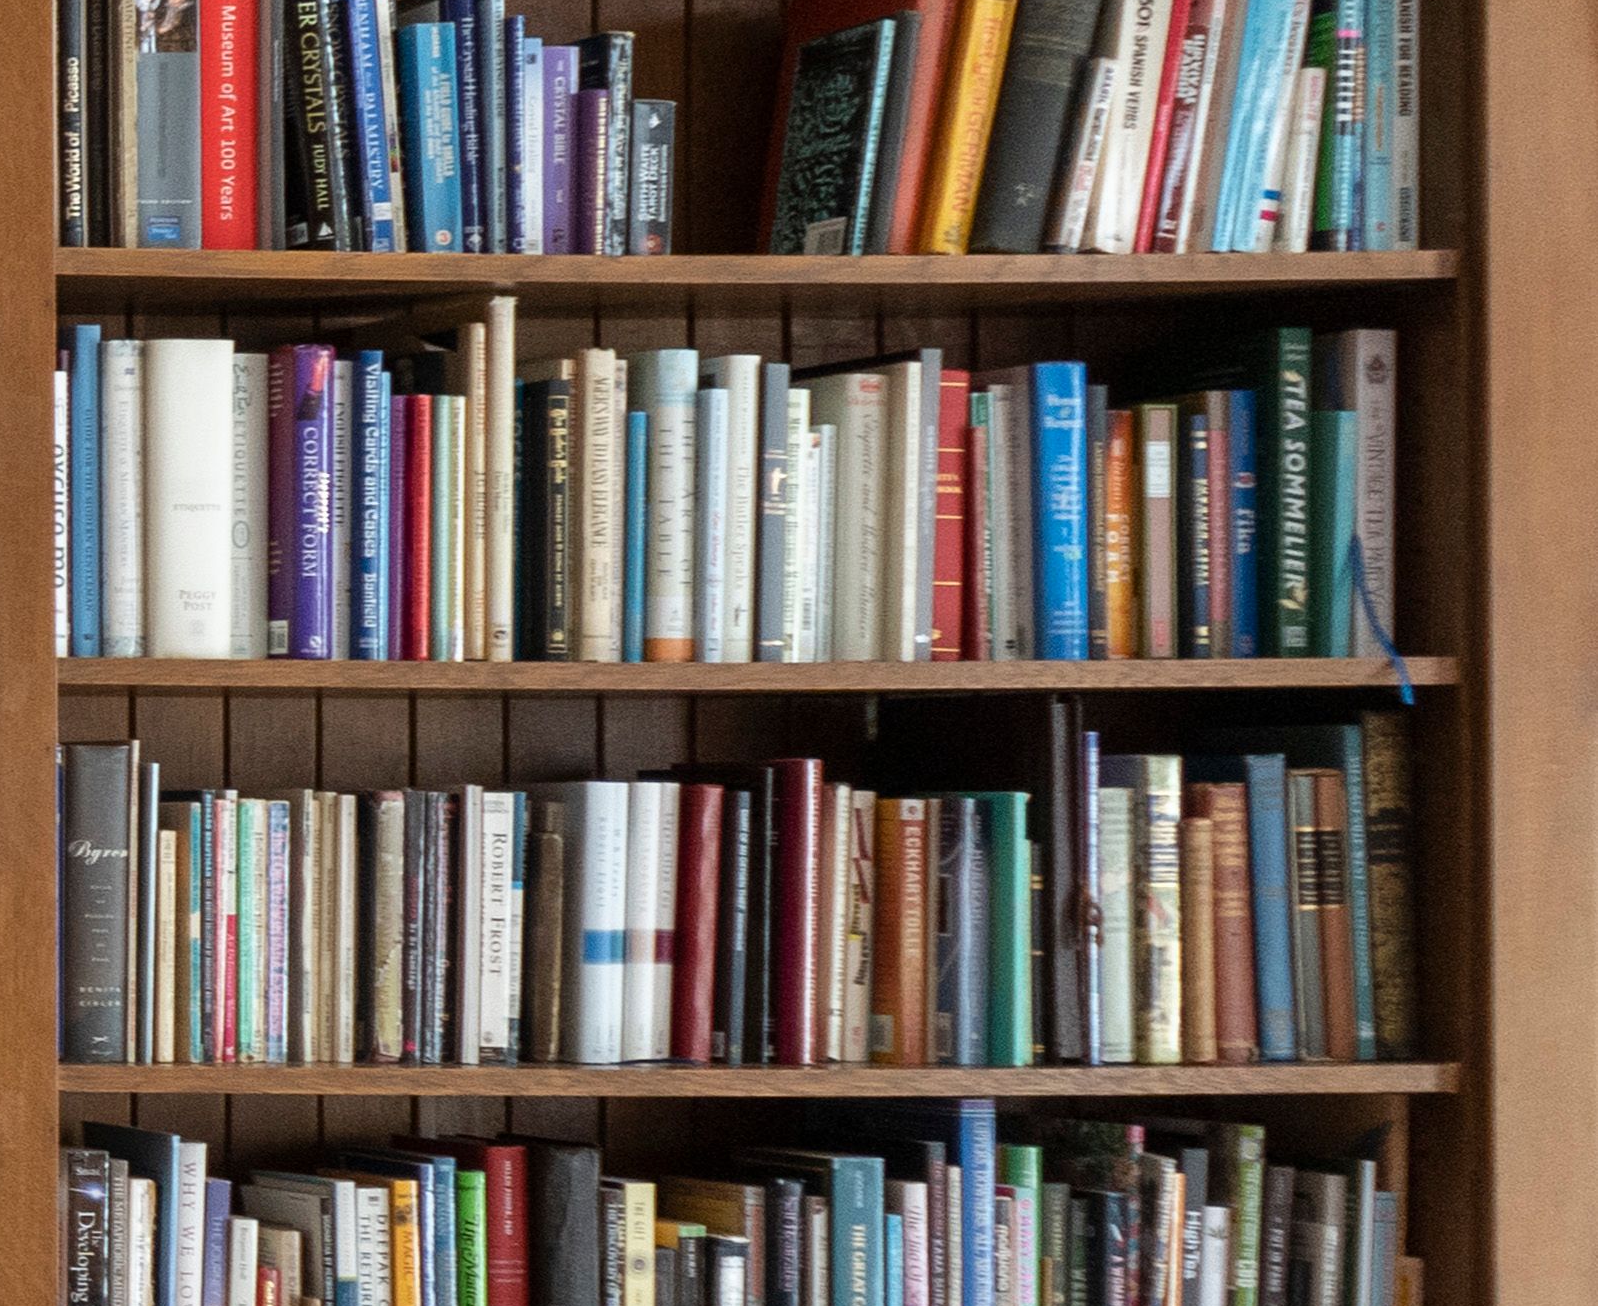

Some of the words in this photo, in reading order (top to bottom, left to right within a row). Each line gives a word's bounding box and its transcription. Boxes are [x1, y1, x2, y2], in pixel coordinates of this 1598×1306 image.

[221, 5, 237, 77] Museum
[219, 82, 238, 100] of
[299, 32, 326, 132] CRYSTALS
[221, 105, 237, 131] Art
[221, 139, 237, 169] 100
[221, 174, 237, 219] Years
[1286, 381, 1306, 429] TEA
[302, 427, 318, 515] CORRECT
[1286, 437, 1306, 587] SOMMELIER
[302, 523, 317, 577] FORM
[70, 1211, 96, 1303] Developing
[853, 1225, 866, 1247] THE
[852, 1251, 866, 1293] GREAT
